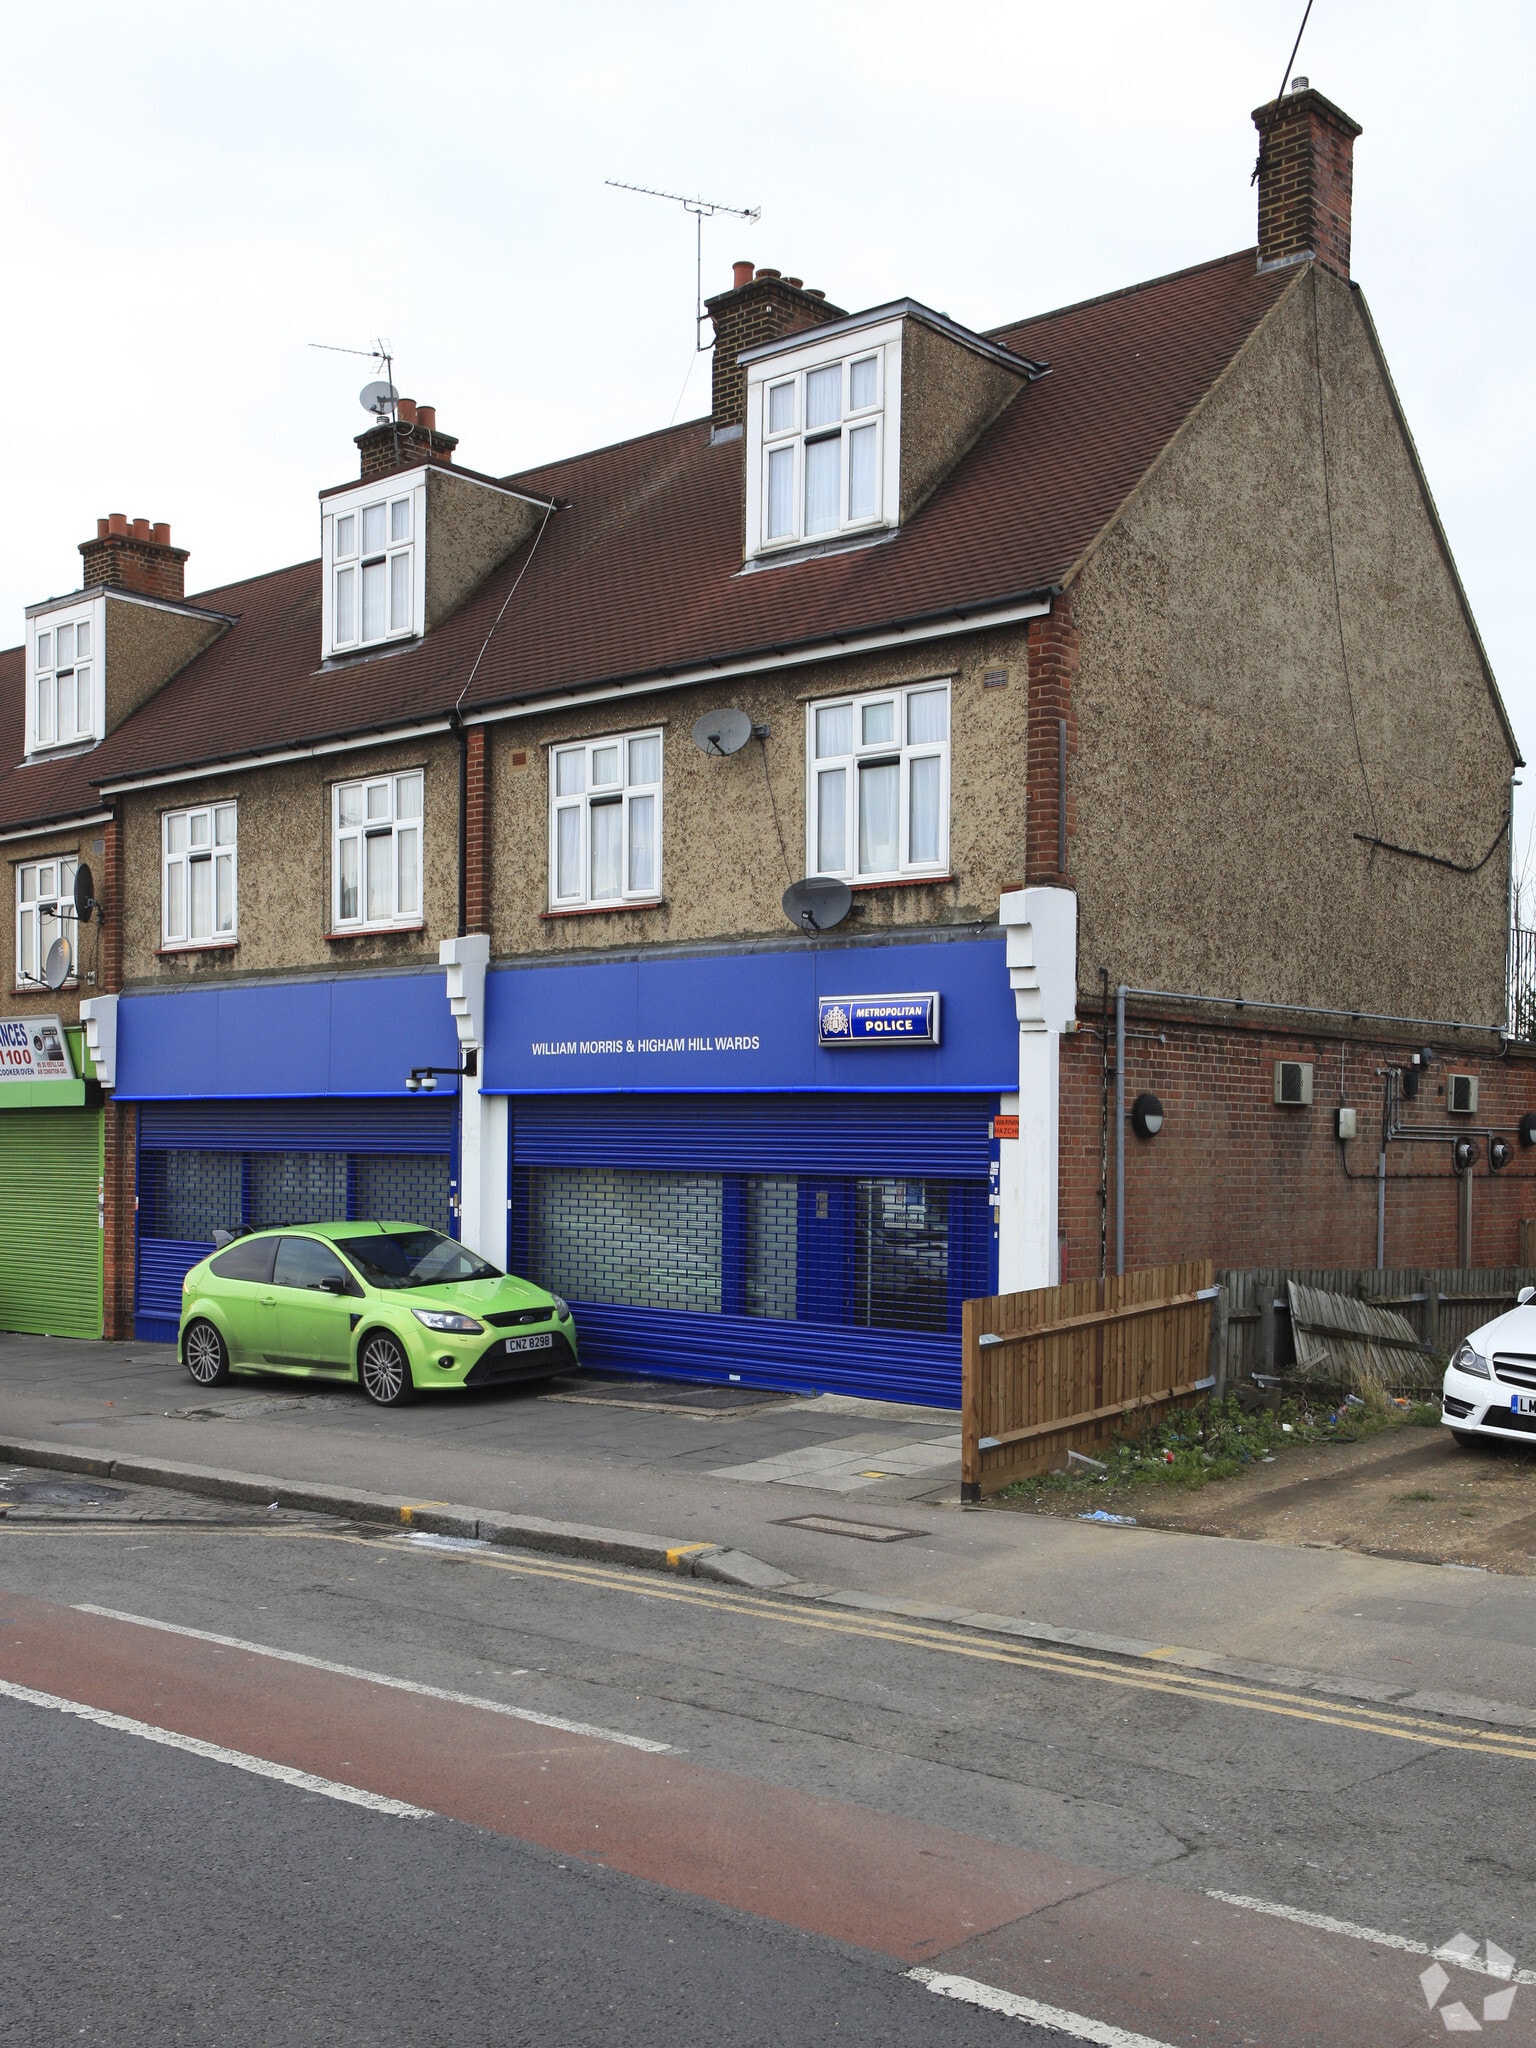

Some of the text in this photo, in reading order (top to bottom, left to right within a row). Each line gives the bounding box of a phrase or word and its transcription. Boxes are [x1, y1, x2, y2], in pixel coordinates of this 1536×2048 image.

[856, 1006, 922, 1017] METROPOLITAN
[865, 1020, 913, 1031] POLICE
[532, 1036, 760, 1056] WILLIAM MORRIS & HIGHAM HILL WARDS
[510, 1336, 550, 1350] CNZ 8298
